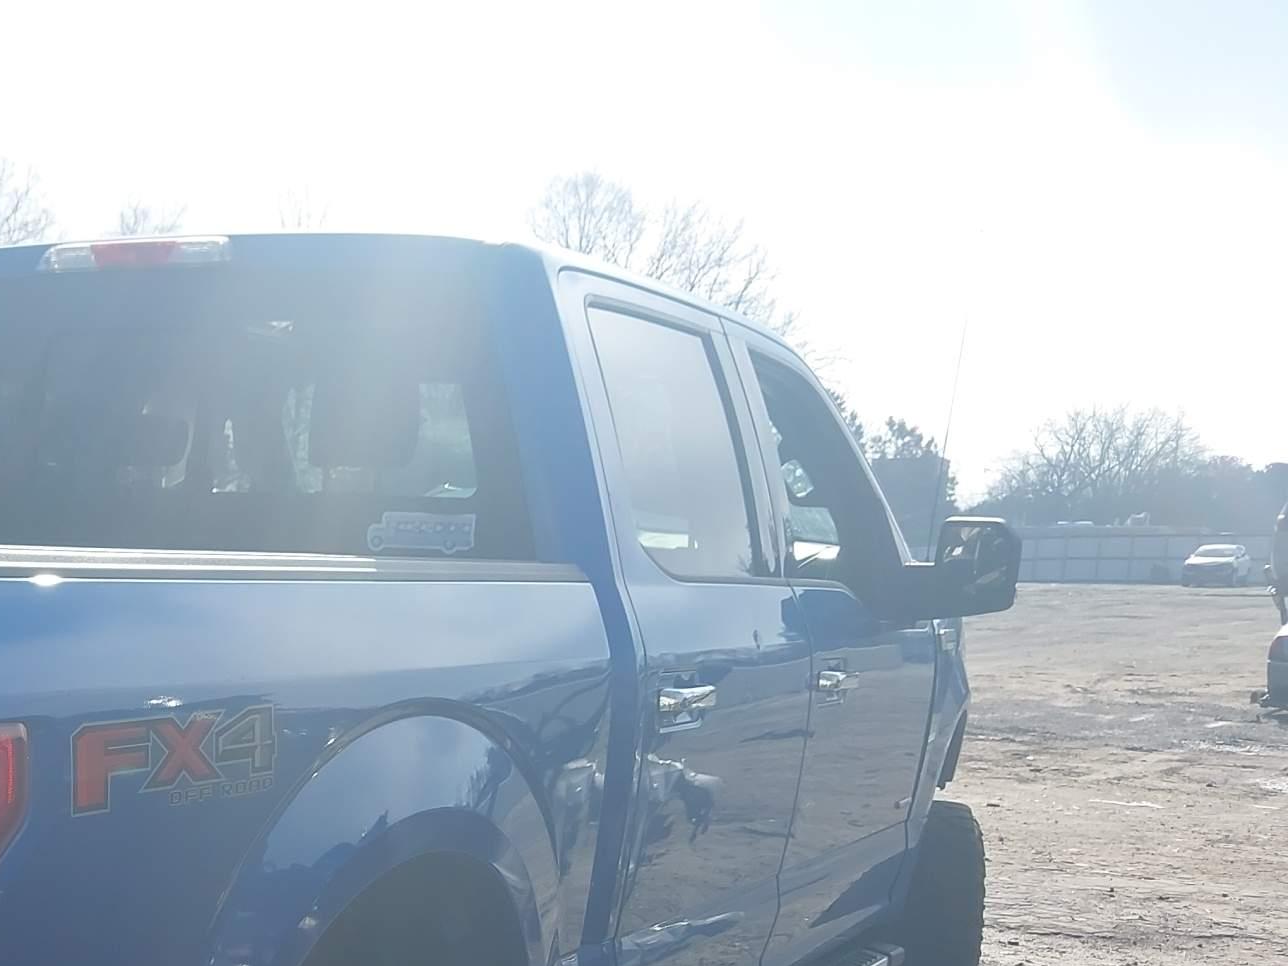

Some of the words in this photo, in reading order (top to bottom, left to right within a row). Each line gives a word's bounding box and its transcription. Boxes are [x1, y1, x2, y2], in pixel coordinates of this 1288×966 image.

[71, 704, 278, 817] FX4
[168, 784, 214, 807] OFF
[219, 775, 273, 799] ROAD
